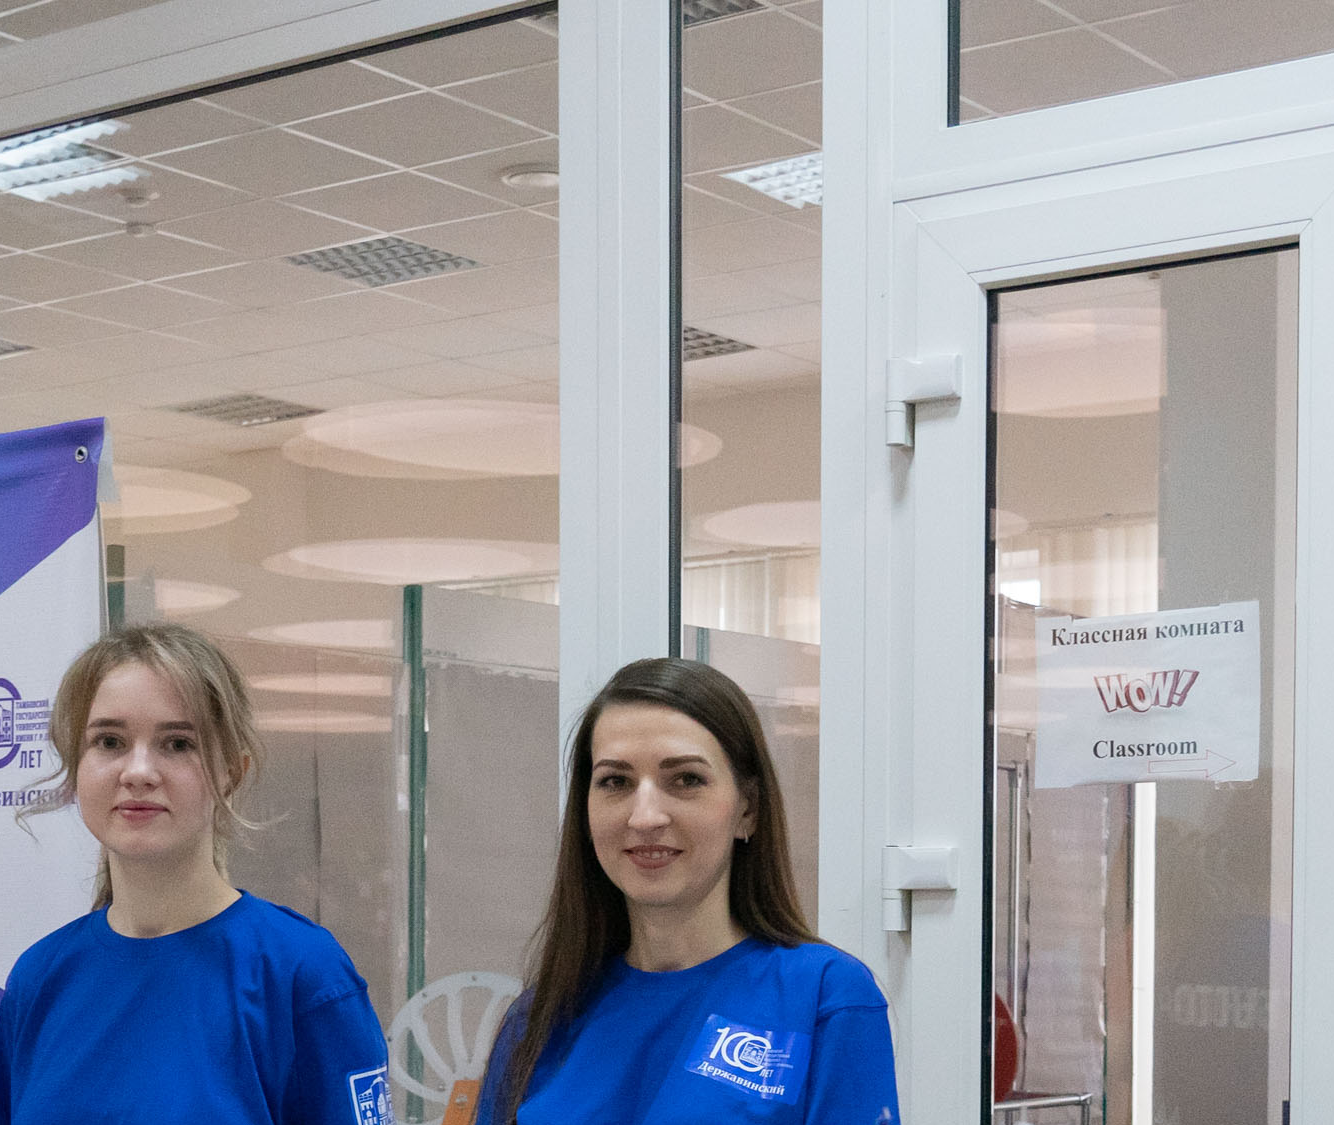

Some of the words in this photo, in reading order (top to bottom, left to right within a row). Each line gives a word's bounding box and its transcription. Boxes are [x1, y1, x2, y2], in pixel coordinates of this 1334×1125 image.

[1051, 627, 1148, 647] Классная
[1155, 618, 1245, 640] комната
[1094, 669, 1199, 713] WOW!
[19, 750, 43, 768] ЛЕТ
[1092, 740, 1198, 759] Classroom
[697, 1061, 785, 1096] Державинский
